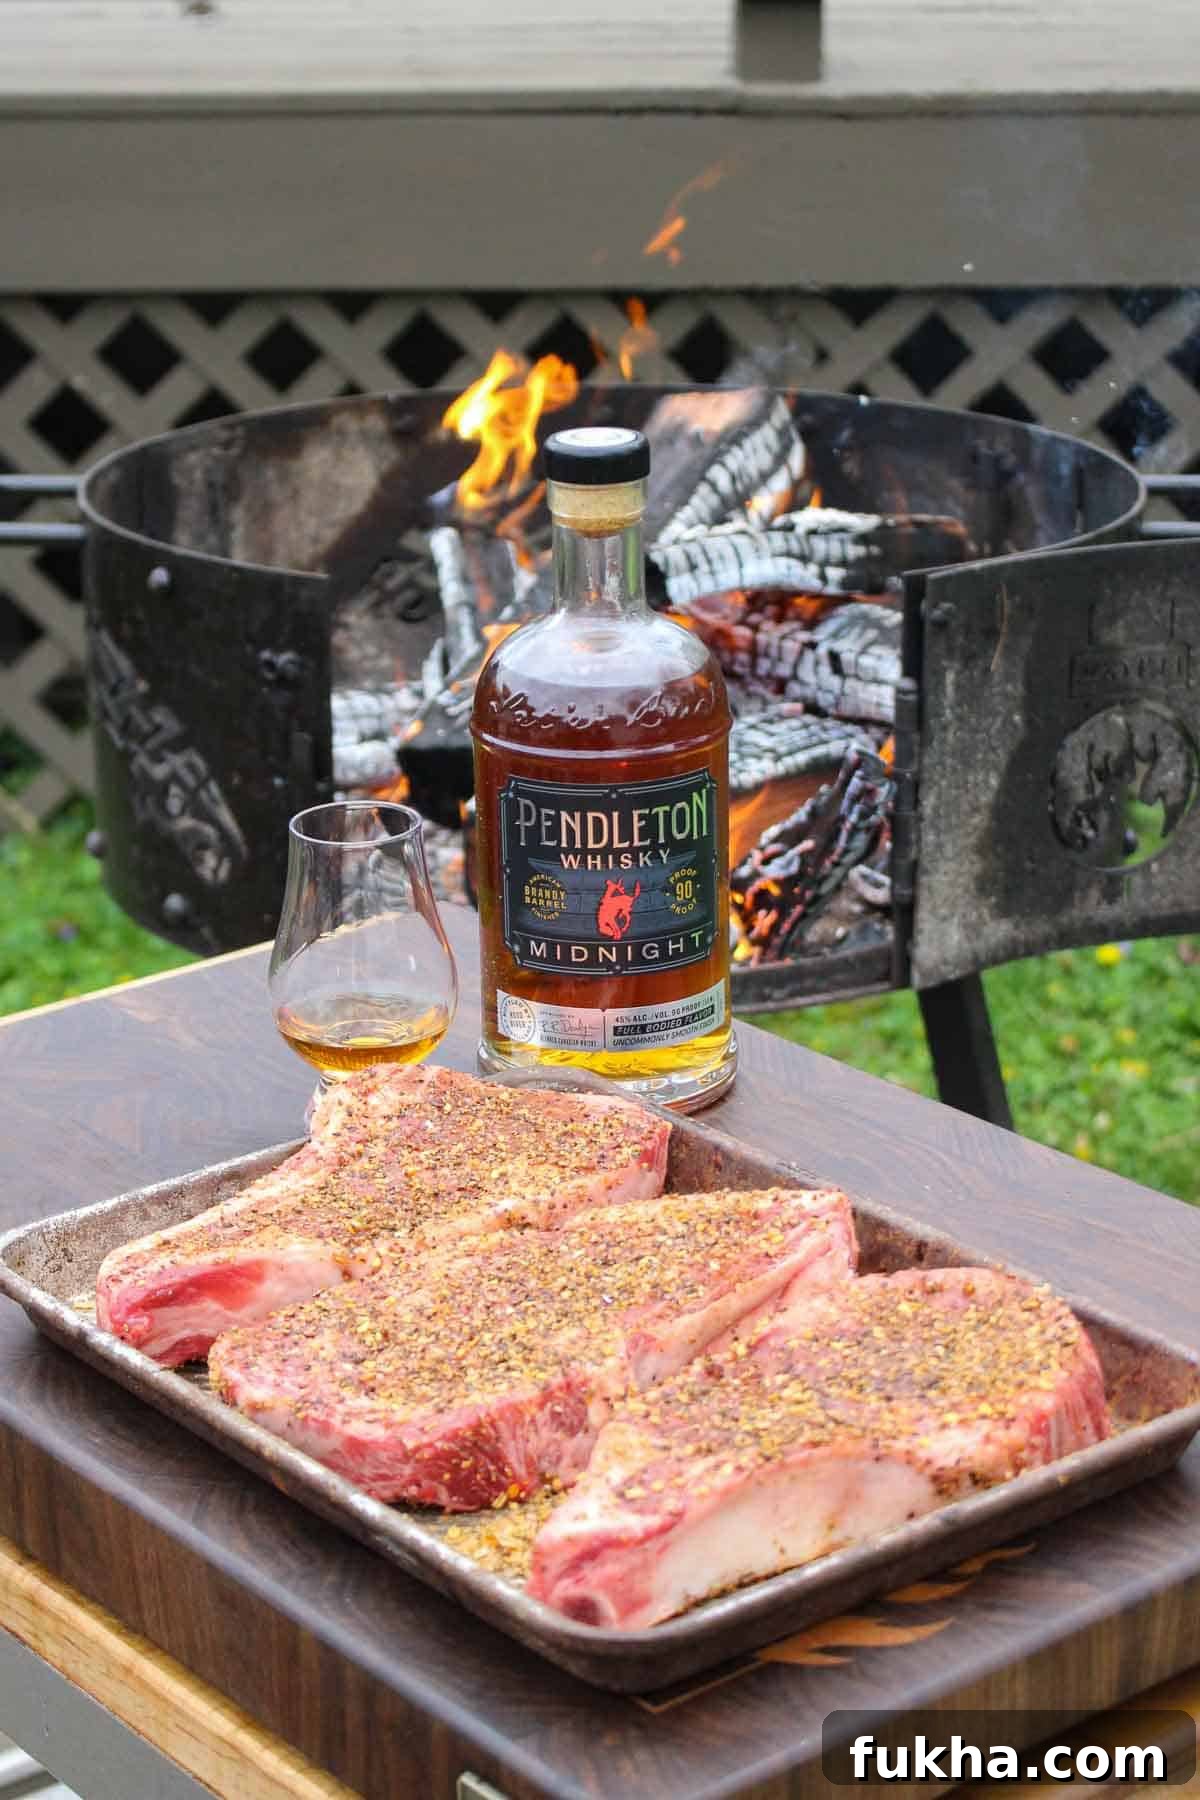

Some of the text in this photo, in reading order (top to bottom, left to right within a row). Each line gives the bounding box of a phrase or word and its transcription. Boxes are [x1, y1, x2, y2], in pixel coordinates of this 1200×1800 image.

[514, 788, 709, 848] PENDLETON
[560, 849, 670, 870] WHISKY
[669, 868, 697, 884] PROOF
[524, 885, 566, 900] BRANDY
[676, 880, 692, 901] 90
[524, 896, 567, 910] BARREL
[530, 930, 704, 962] MIDNIGHT
[616, 1025, 642, 1035] FULL
[646, 1018, 682, 1032] BODIED
[684, 1007, 713, 1023] FLAVOR
